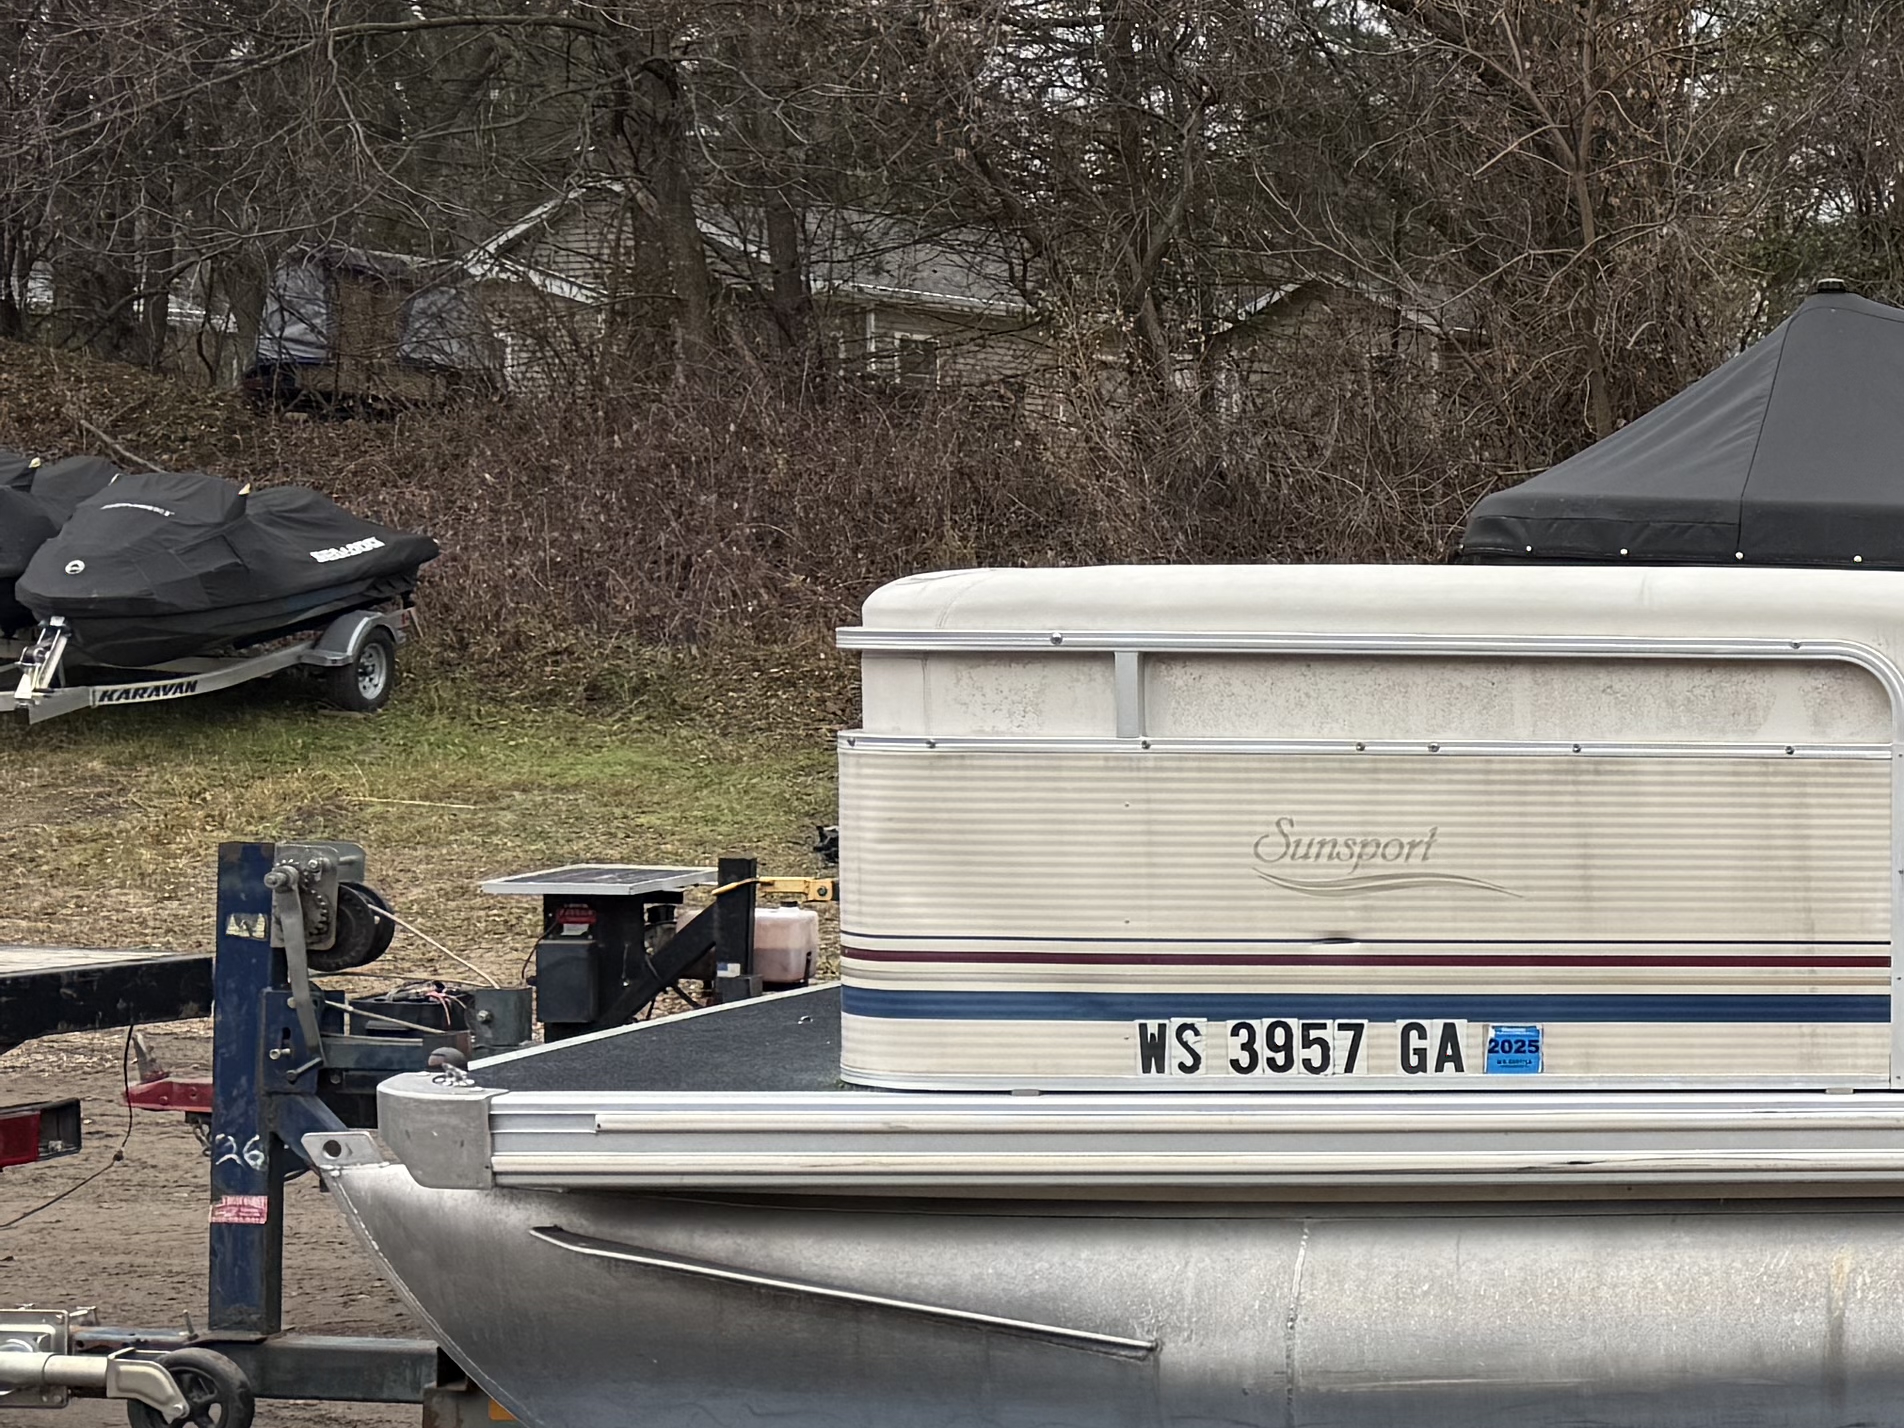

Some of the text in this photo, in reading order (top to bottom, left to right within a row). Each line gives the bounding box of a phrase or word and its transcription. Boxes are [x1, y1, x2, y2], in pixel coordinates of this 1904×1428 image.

[99, 679, 198, 703] KARAVAN
[1253, 816, 1438, 874] Sunsport
[1138, 1021, 1465, 1075] WS 3957 GA
[1488, 1038, 1540, 1054] 2025
